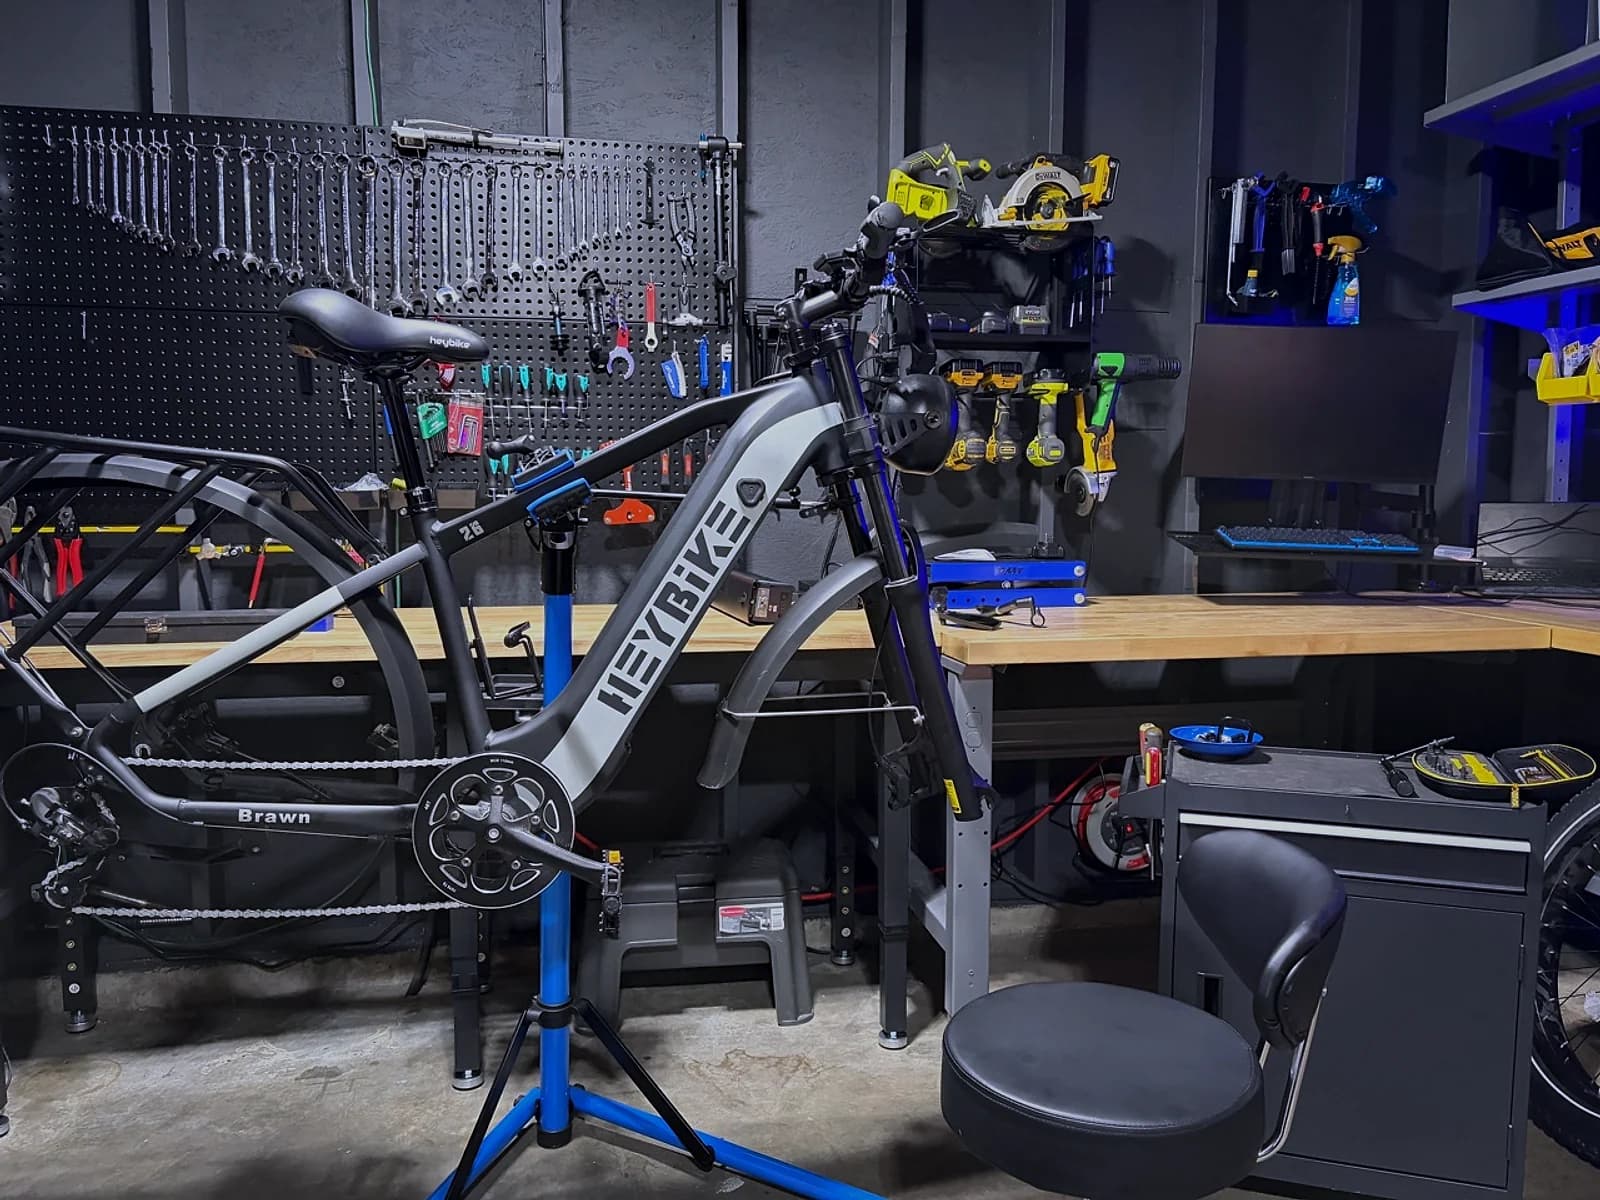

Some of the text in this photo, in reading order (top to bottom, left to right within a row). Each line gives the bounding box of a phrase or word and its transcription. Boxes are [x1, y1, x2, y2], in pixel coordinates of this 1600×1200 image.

[429, 336, 471, 349] heybike
[459, 520, 485, 541] 26
[238, 808, 311, 824] Brawn
